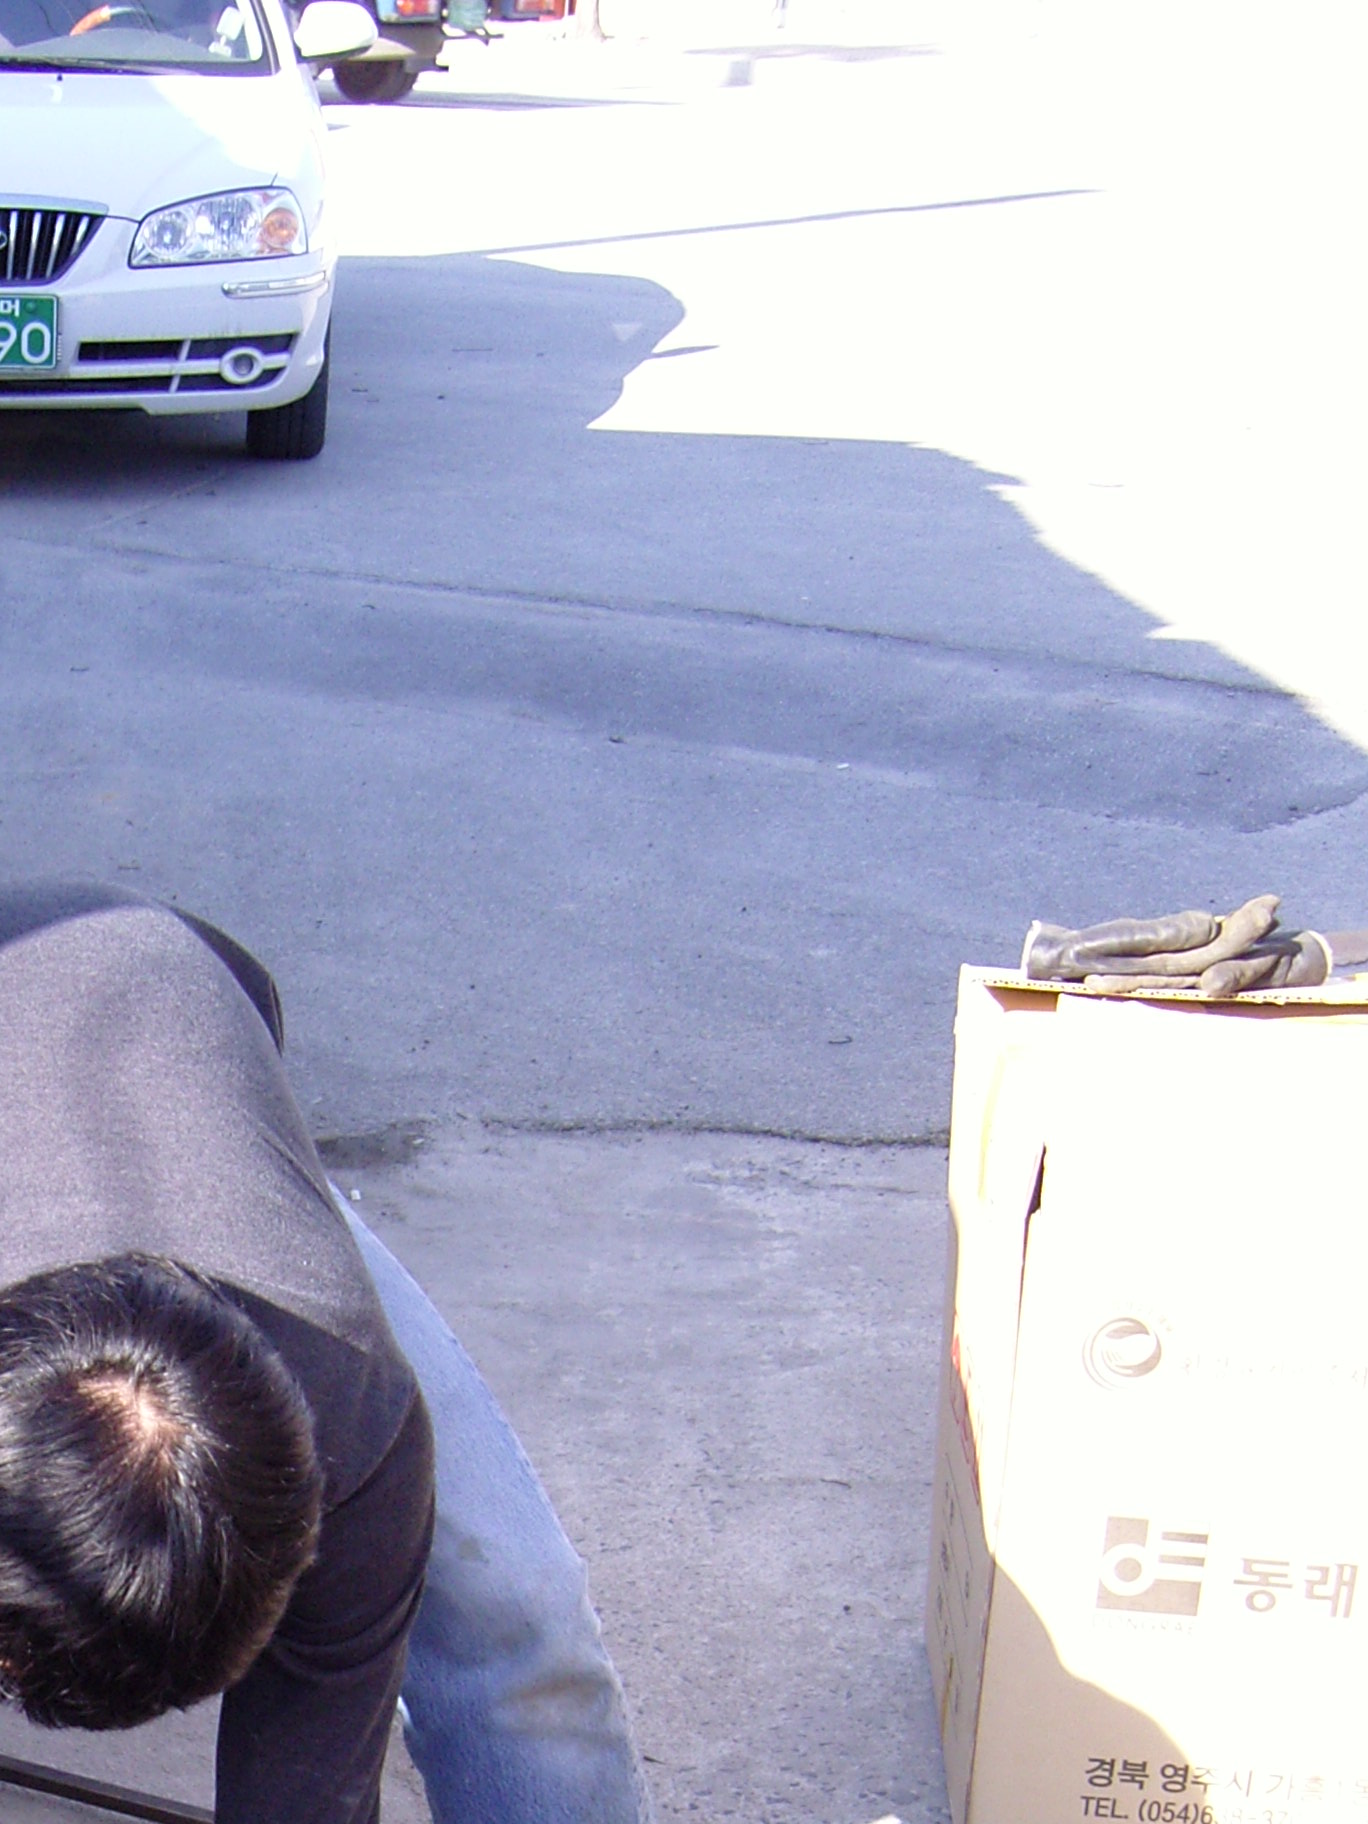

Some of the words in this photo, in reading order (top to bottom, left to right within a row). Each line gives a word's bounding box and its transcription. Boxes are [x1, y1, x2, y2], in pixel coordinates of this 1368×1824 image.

[1233, 1557, 1359, 1619] 동래
[1085, 1757, 1150, 1790] 경북
[1159, 1763, 1253, 1798] 영주시
[1080, 1795, 1130, 1820] TEL.
